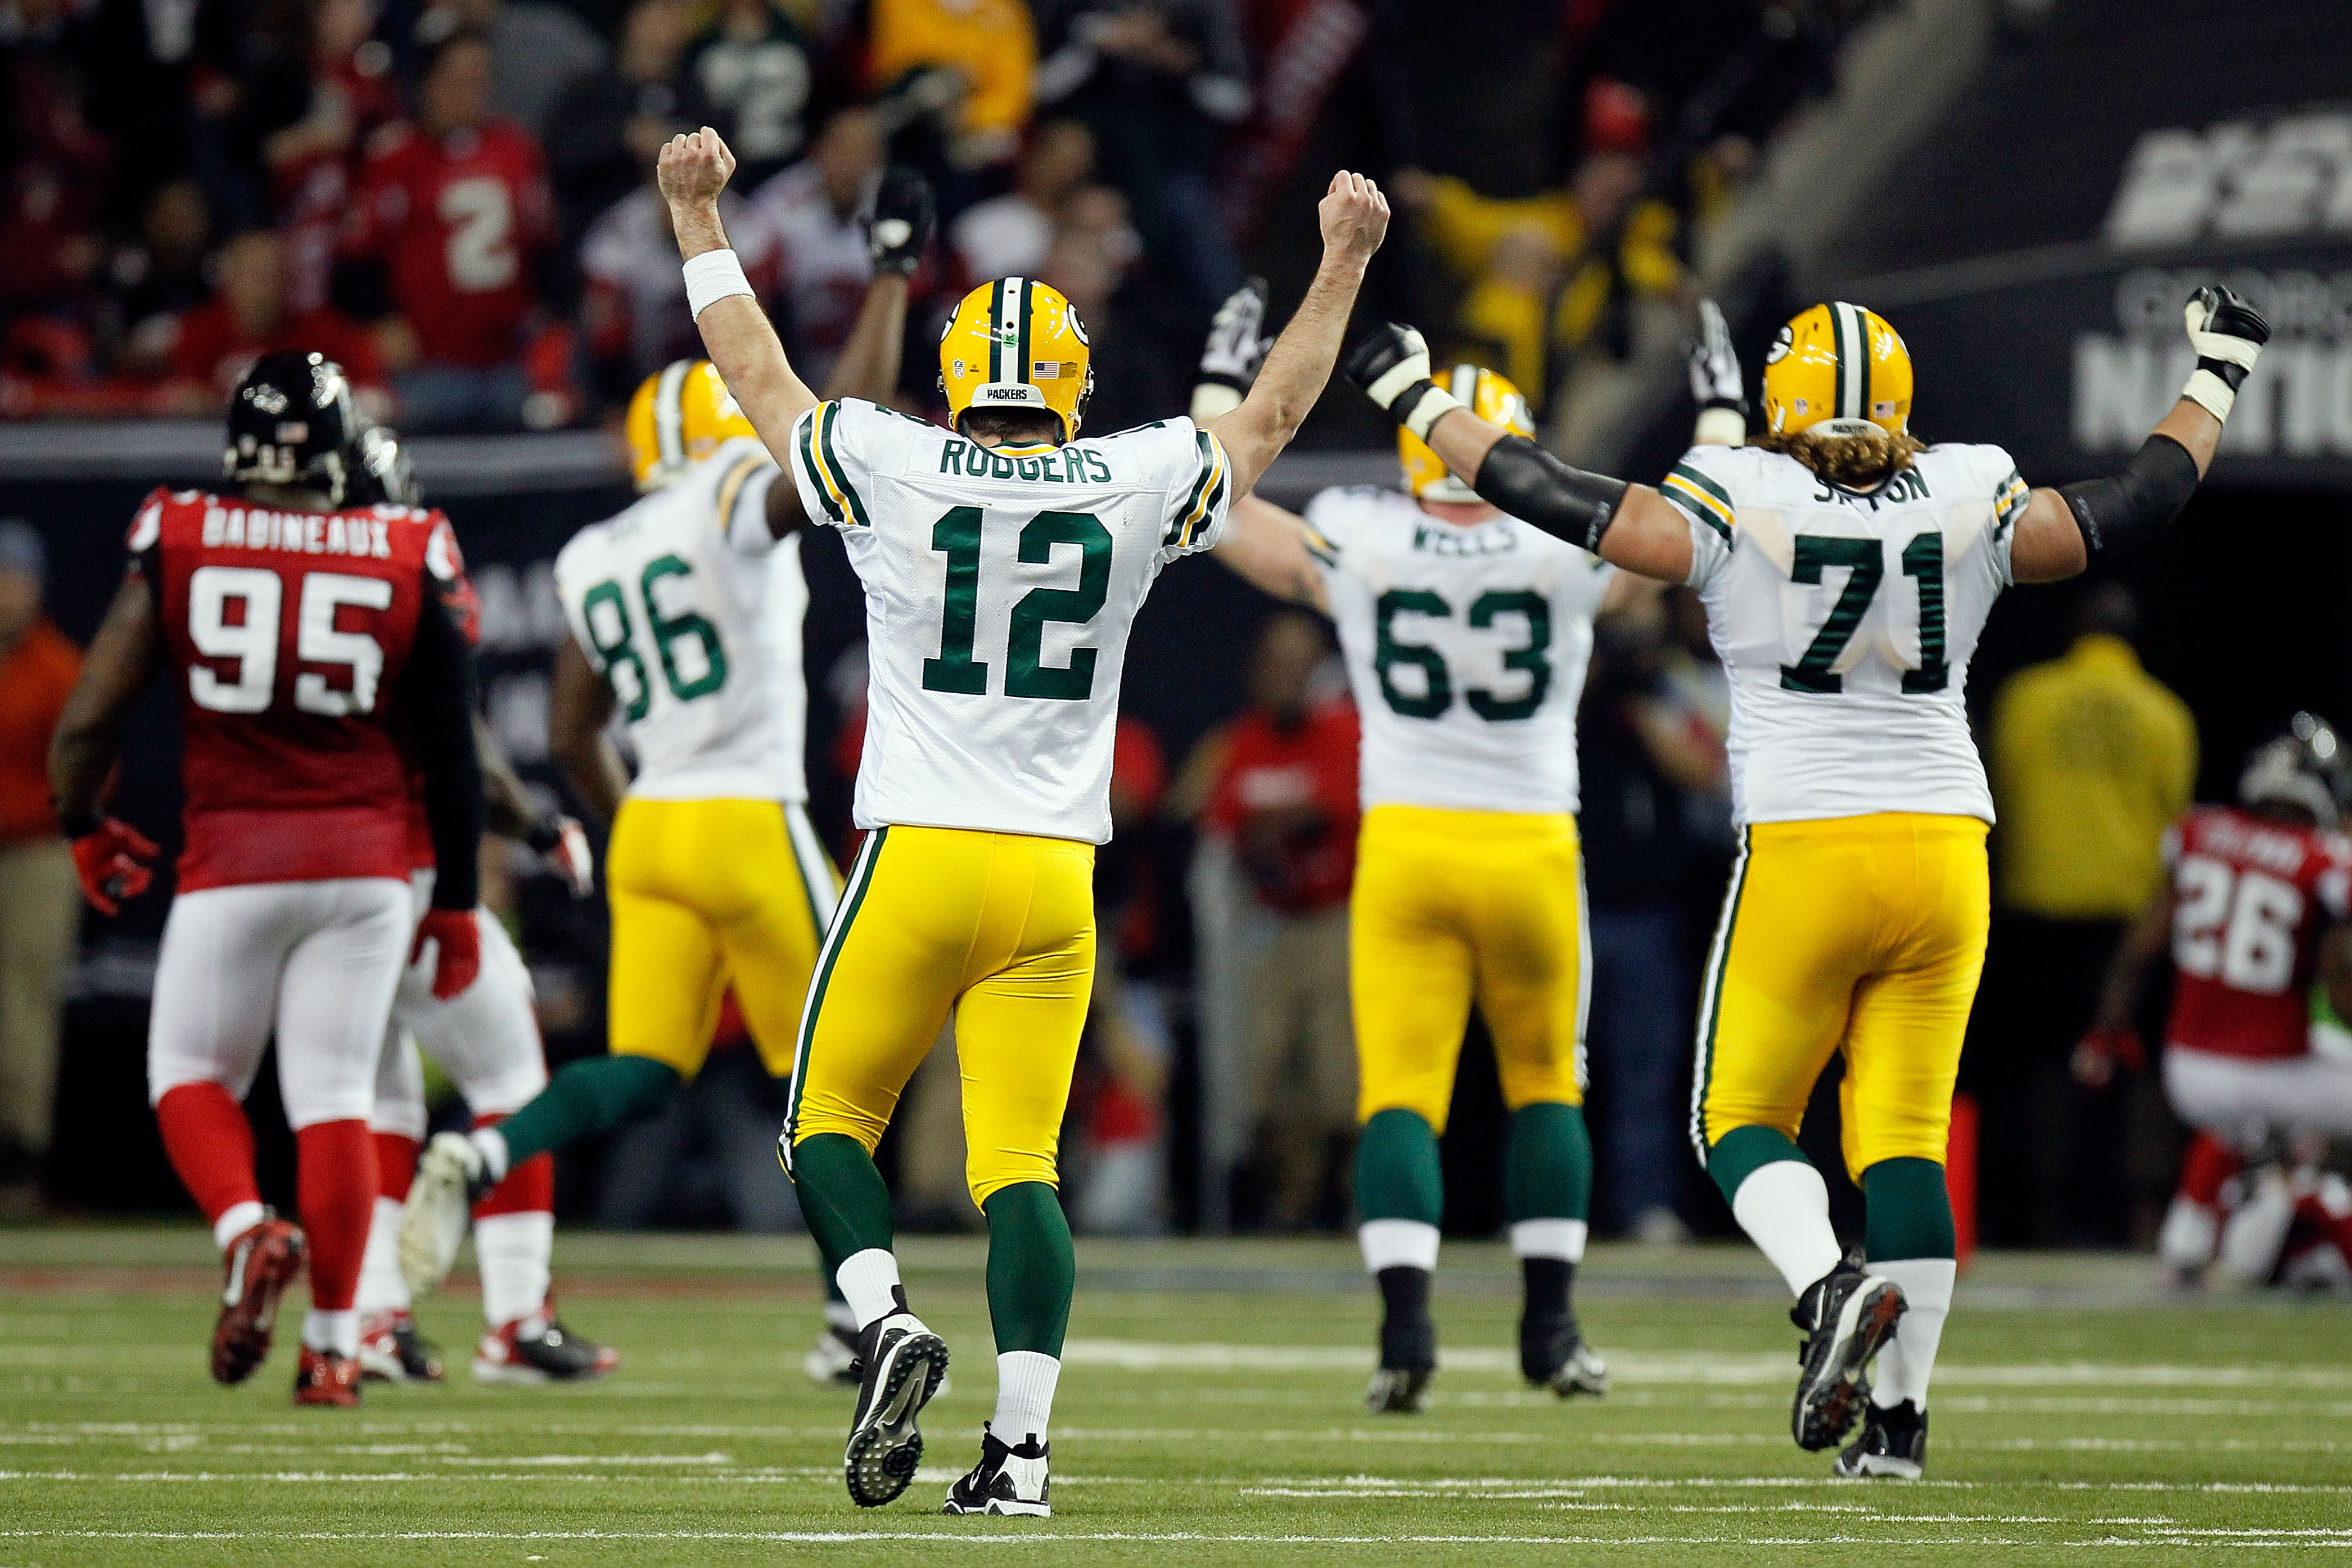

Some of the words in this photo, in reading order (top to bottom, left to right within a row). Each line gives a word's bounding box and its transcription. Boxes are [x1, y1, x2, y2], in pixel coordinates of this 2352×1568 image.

[440, 176, 518, 292] 2
[940, 439, 1112, 483] RODGERS
[987, 388, 1027, 401] PACKERS
[1814, 465, 1931, 512] SON
[188, 566, 392, 717] 95
[585, 555, 728, 723] 86
[922, 505, 1113, 700] 12
[1375, 588, 1551, 721] 63
[1780, 532, 1949, 694] 71
[2172, 852, 2304, 995] 26
